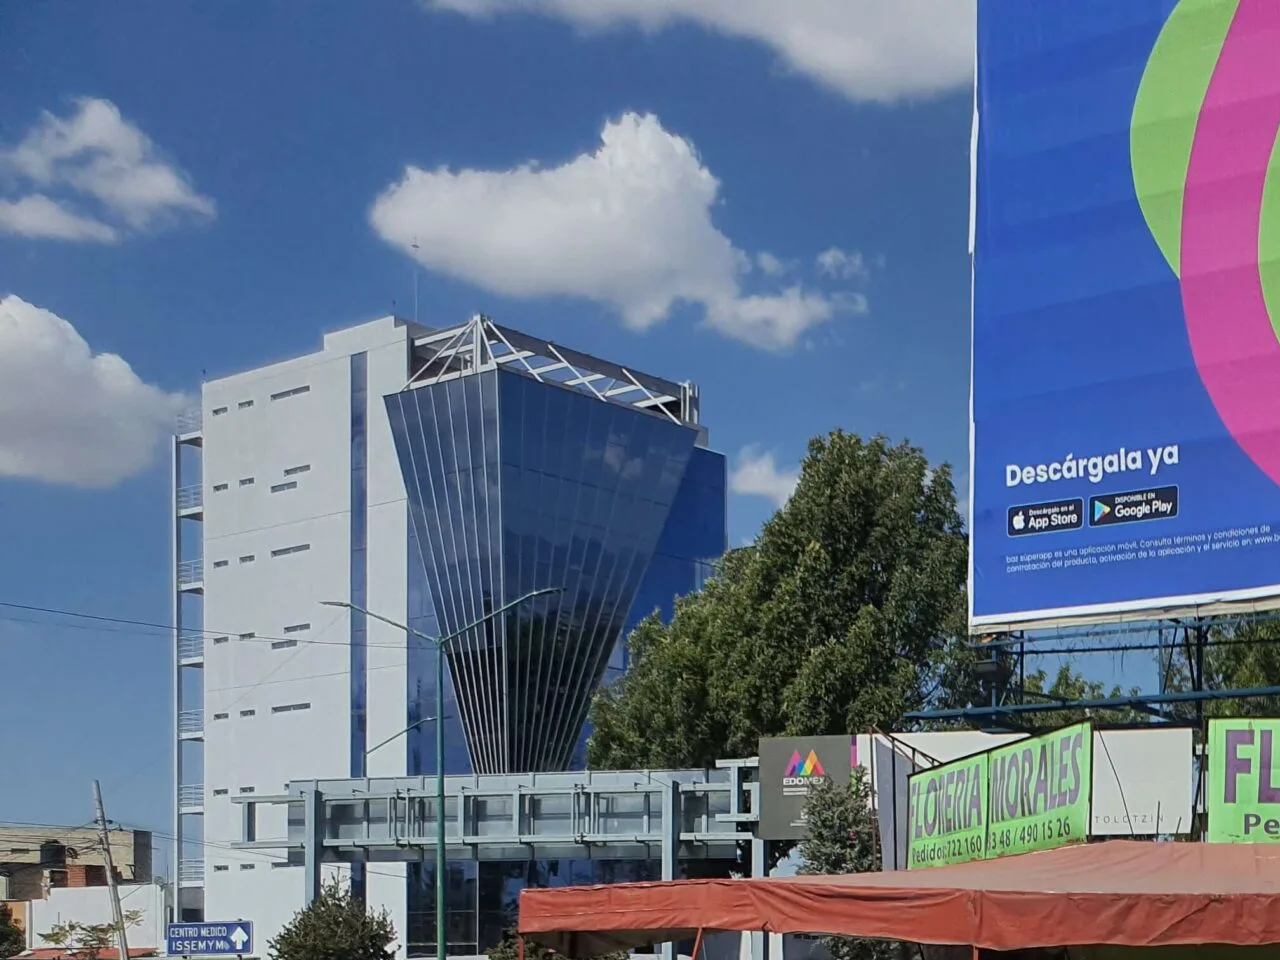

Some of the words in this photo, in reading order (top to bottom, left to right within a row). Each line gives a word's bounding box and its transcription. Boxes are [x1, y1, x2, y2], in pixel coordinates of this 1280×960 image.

[1006, 447, 1142, 487] Descárgala
[1147, 444, 1178, 475] ya
[1115, 494, 1147, 504] DISPONIBLE
[1147, 492, 1156, 500] EN
[1115, 502, 1150, 518] Google
[1152, 500, 1173, 514] Play
[1028, 516, 1049, 529] App
[1051, 513, 1077, 525] Store
[1064, 547, 1077, 556] una
[1079, 542, 1116, 556] aplicación
[1139, 534, 1172, 548] Consulta
[1173, 533, 1206, 545] términos
[1213, 527, 1259, 540] condiciones
[1260, 524, 1271, 533] de
[1006, 559, 1051, 573] contratación
[1052, 559, 1063, 568] del
[1099, 551, 1137, 563] activación
[1138, 550, 1148, 558] de
[1149, 549, 1156, 557] la
[1157, 545, 1196, 557] aplicación
[1203, 542, 1210, 551] el
[1212, 539, 1240, 551] servicio
[991, 732, 1084, 823] MORALES
[965, 834, 982, 856] 160
[1000, 829, 1011, 848] 48
[1019, 823, 1038, 844] 490
[1042, 820, 1053, 840] 15
[1056, 816, 1071, 838] 26
[170, 927, 198, 938] CENTRO
[201, 926, 227, 937] MEDICO
[172, 940, 224, 951] ISSEMYM
